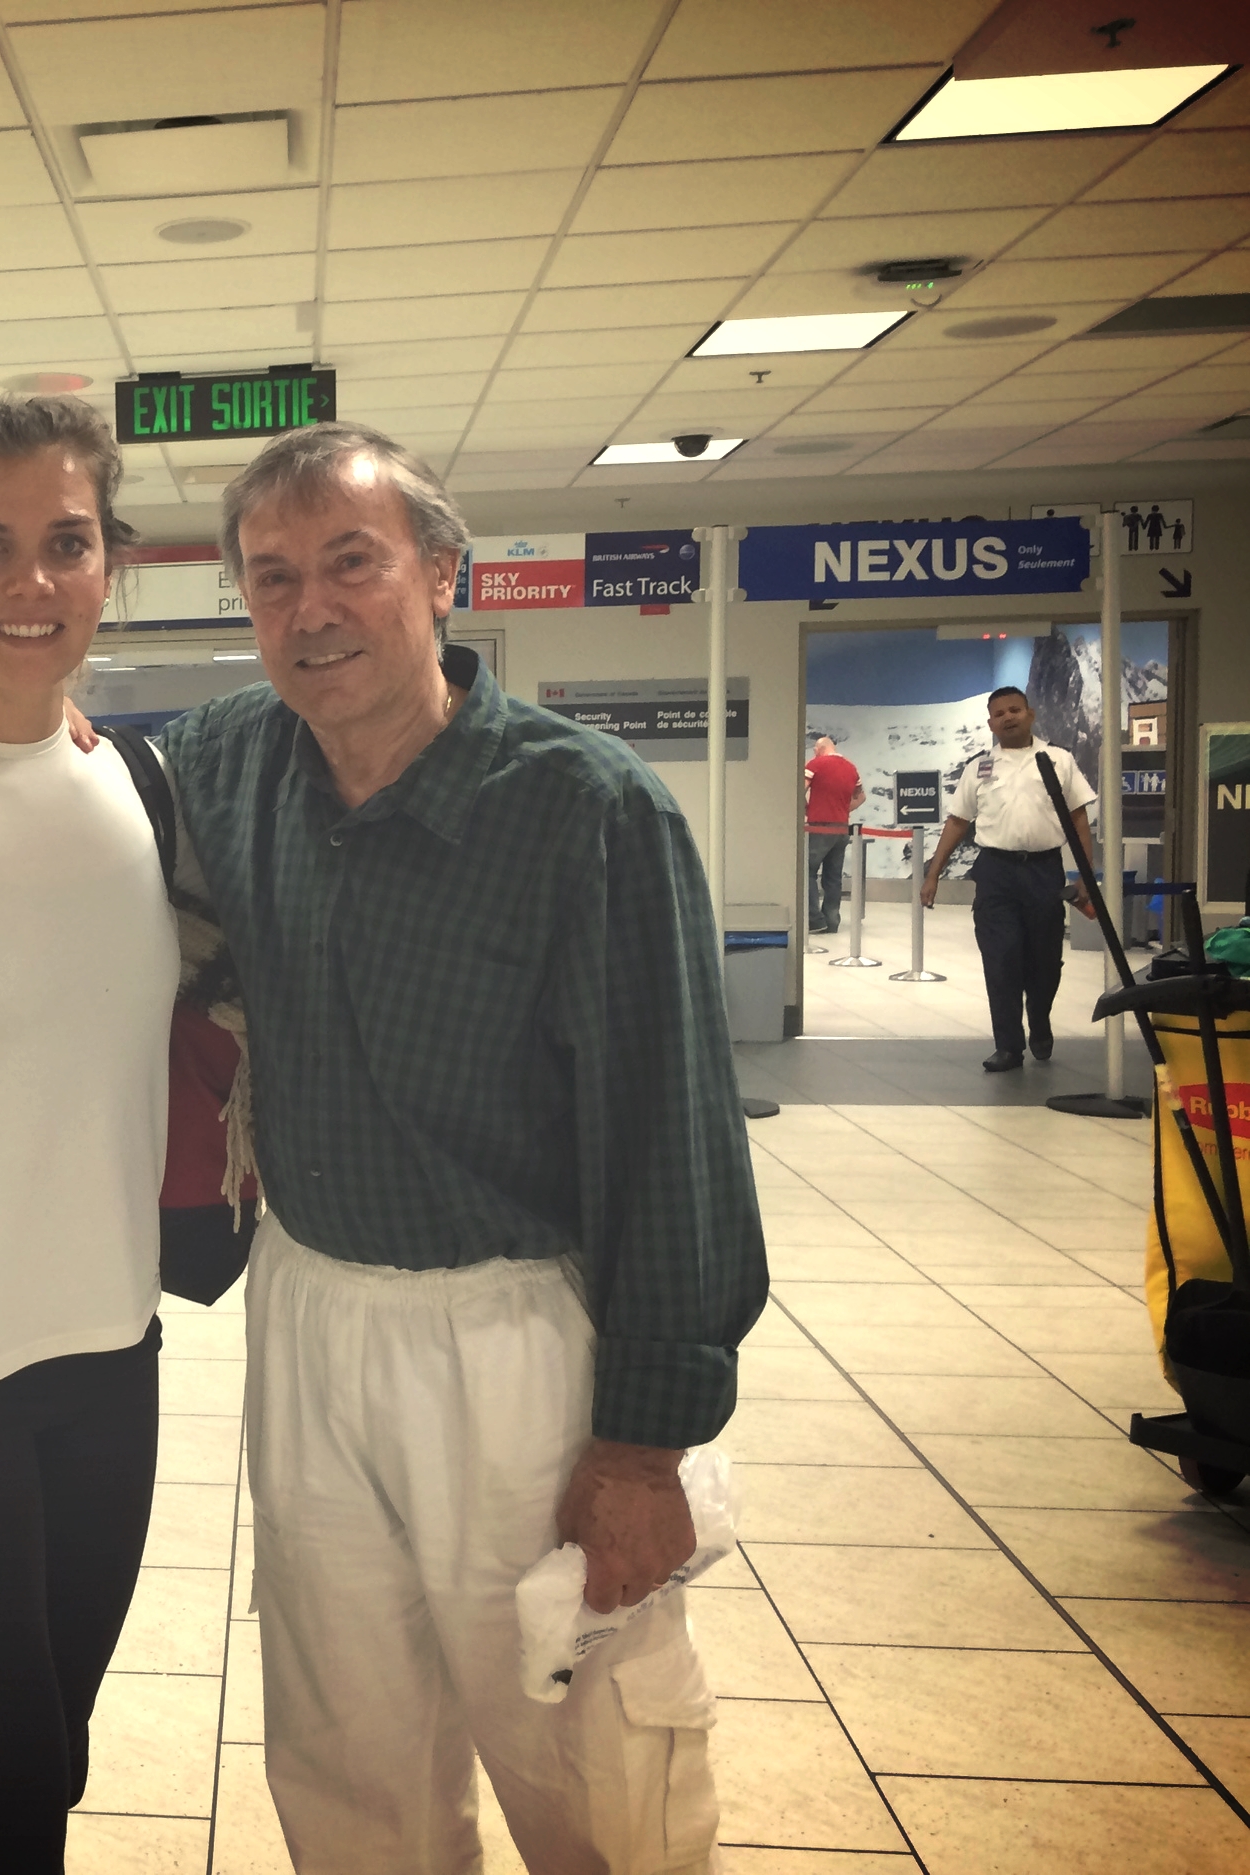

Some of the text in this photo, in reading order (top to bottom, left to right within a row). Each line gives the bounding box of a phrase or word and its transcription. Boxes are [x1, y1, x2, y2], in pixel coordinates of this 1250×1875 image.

[133, 377, 318, 435] EXIT SORTIE
[507, 548, 535, 557] KLM
[1017, 544, 1043, 556] Only
[592, 553, 623, 562] BRITISH
[813, 536, 1009, 583] NEXUS
[1017, 557, 1076, 570] Seulement
[481, 572, 520, 587] SKY
[592, 575, 693, 598] Fast Track
[481, 585, 572, 601] PRIORITY
[574, 712, 612, 723] Security
[656, 711, 681, 720] Point
[683, 710, 696, 719] de
[623, 721, 647, 730] Point
[656, 720, 709, 729] de sécurité
[899, 786, 937, 797] NEXUS
